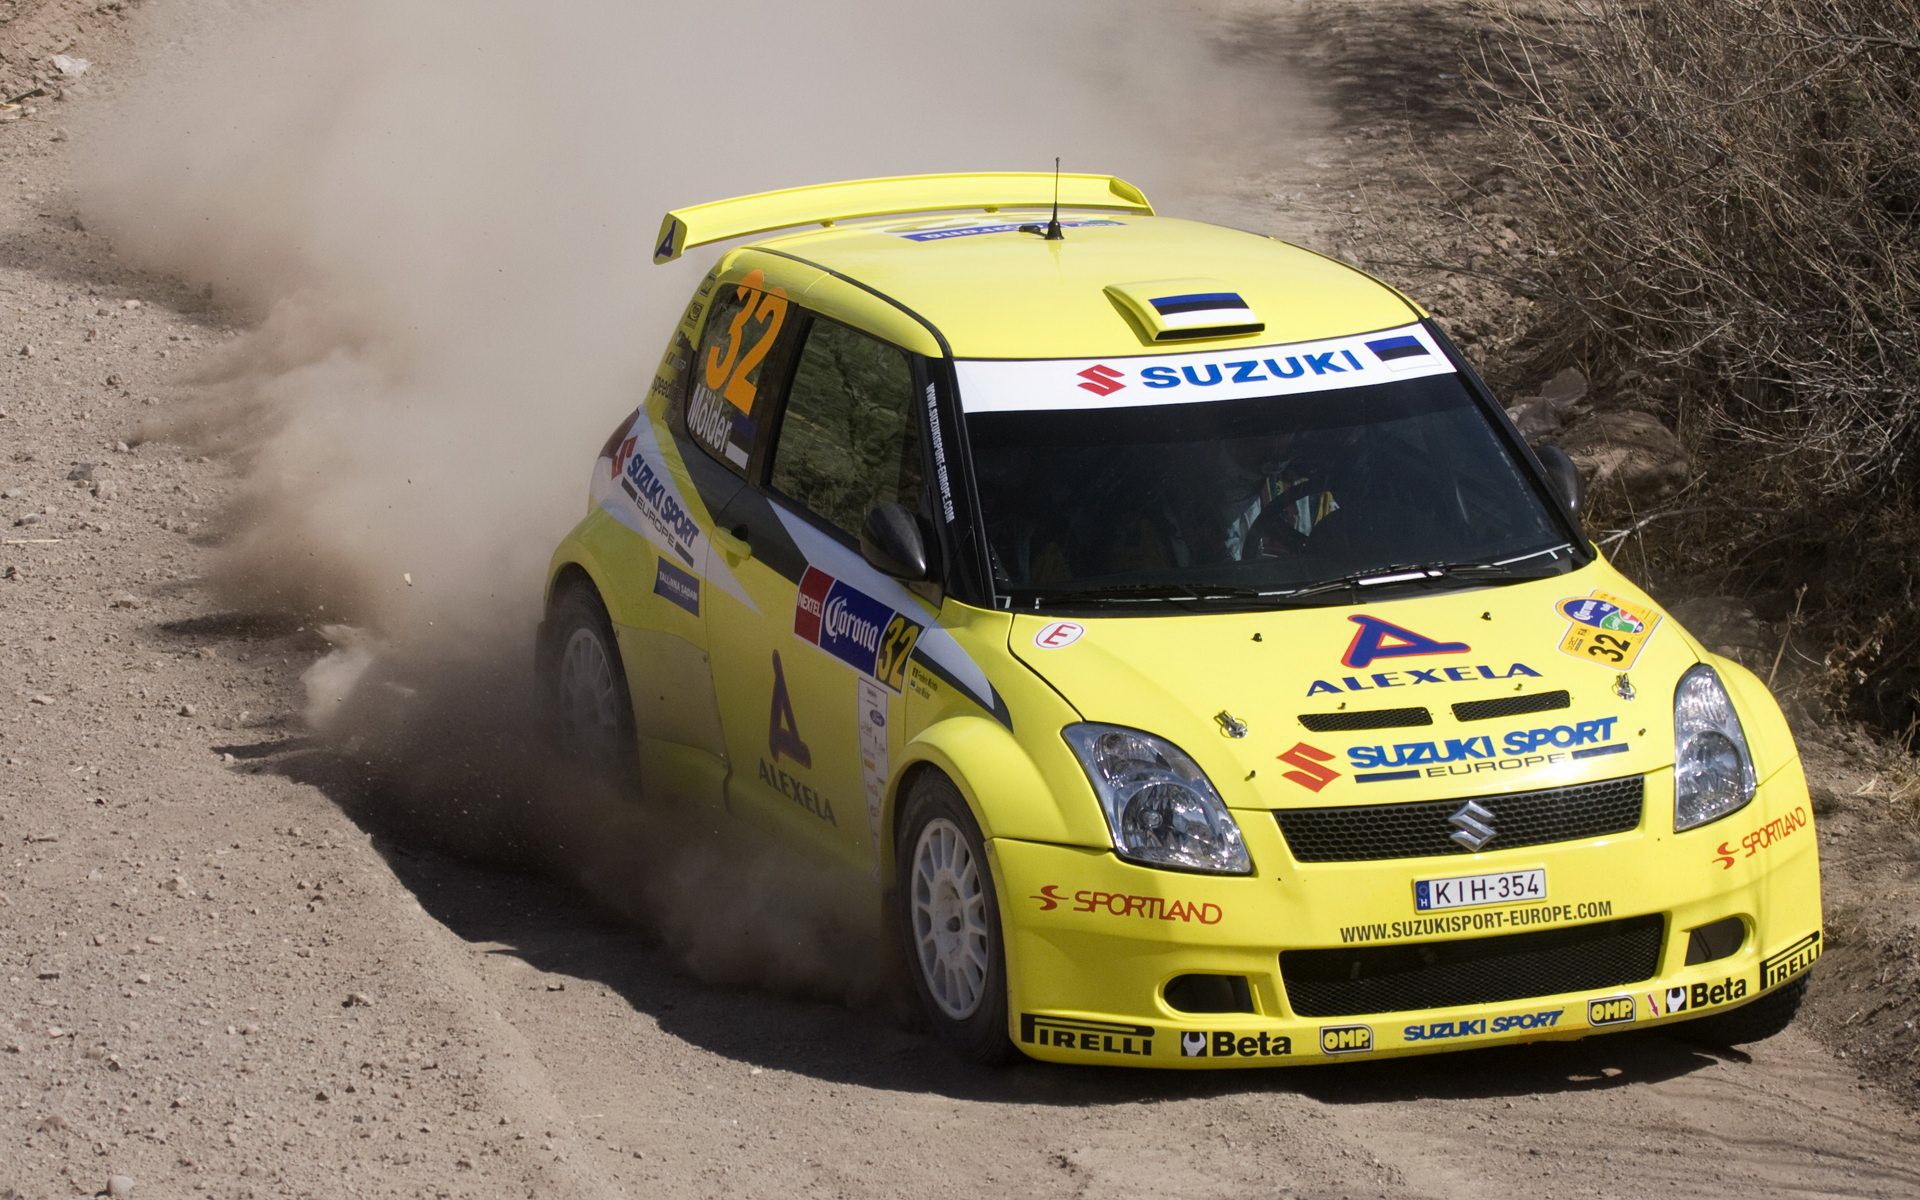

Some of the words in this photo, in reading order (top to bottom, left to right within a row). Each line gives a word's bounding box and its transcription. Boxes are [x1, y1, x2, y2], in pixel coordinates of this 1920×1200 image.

[706, 269, 788, 416] 32
[1140, 350, 1364, 390] SUZUKI
[687, 383, 733, 452] Mölder
[926, 382, 955, 523] WWW.SUZUKISPORT-EUROPE.COM
[627, 453, 666, 513] SUZUKI
[661, 496, 699, 548] SPORT
[636, 496, 675, 548] EUROPE
[797, 593, 822, 618] NEXTEL
[825, 596, 879, 653] Corona
[877, 618, 919, 692] 32
[1043, 624, 1077, 645] E
[1588, 634, 1631, 662] 32
[1306, 662, 1543, 697] ALEXELA
[1347, 735, 1496, 769] SUZUKI
[1503, 716, 1618, 756] SPORT
[1426, 753, 1568, 778] EUROPE
[759, 757, 838, 828] ALEXELA
[1742, 806, 1808, 858] SPORTLAND
[1073, 890, 1222, 925] SPORTLAND
[1420, 899, 1428, 907] H
[1436, 874, 1539, 904] KIH-354
[1340, 900, 1613, 943] WWW.SUZUKISPORT-EUROPE.COM
[1760, 930, 1821, 991] PIRELLI
[1691, 977, 1747, 1008] Beta
[1020, 1012, 1155, 1056] PIRELLI
[1212, 1031, 1292, 1057] Beta
[1404, 1019, 1486, 1041] SUZUKI
[1490, 1010, 1564, 1032] SPORT
